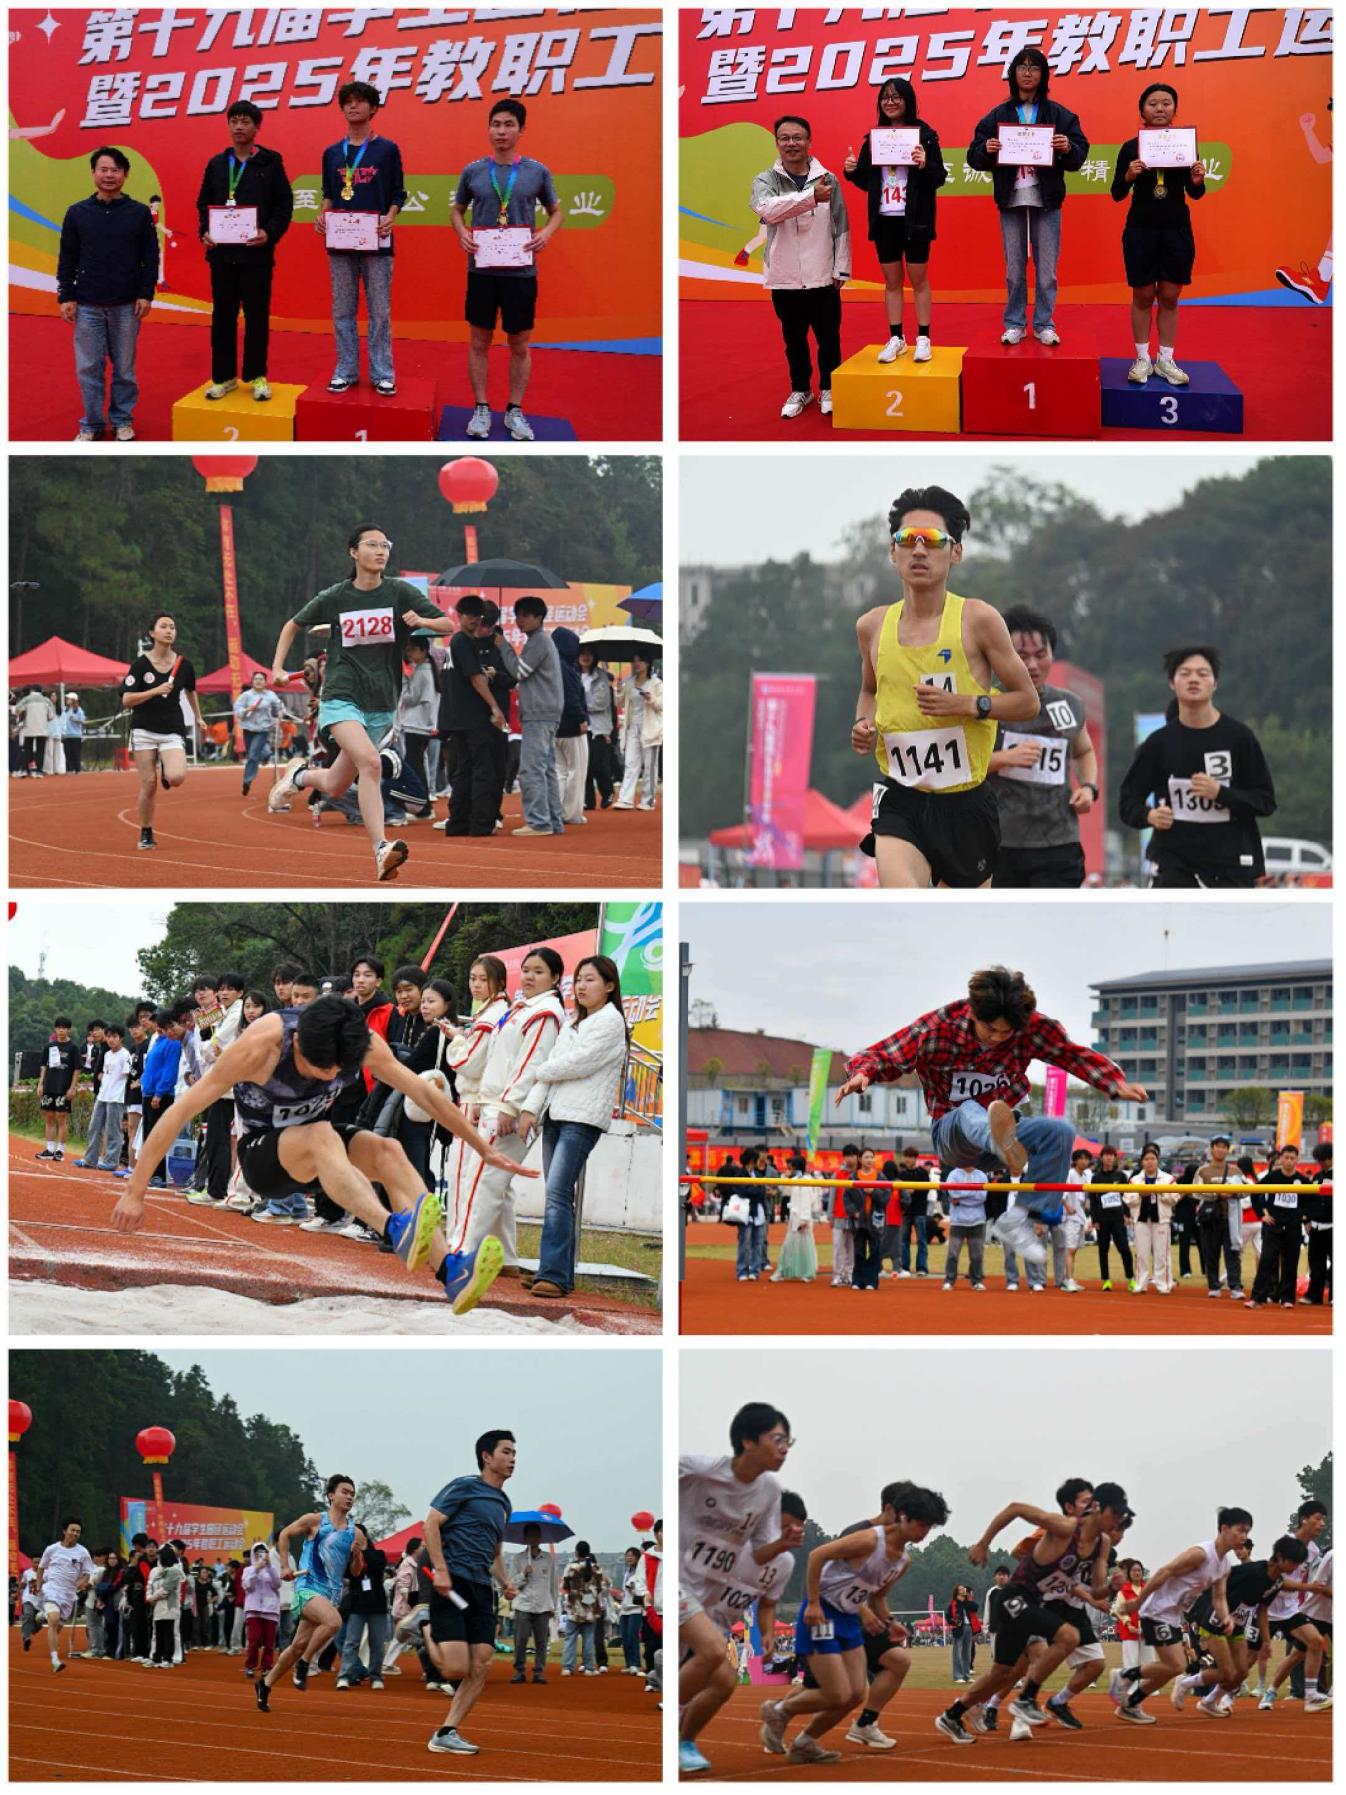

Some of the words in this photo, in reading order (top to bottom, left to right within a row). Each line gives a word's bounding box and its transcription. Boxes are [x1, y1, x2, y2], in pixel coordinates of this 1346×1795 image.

[885, 390, 904, 417] 2
[1023, 382, 1036, 409] 1
[1160, 396, 1179, 424] 3
[343, 616, 391, 638] 2128
[1049, 705, 1072, 728] 10
[890, 739, 962, 777] 1141
[1208, 755, 1229, 777] 3
[692, 1542, 736, 1573] 1190
